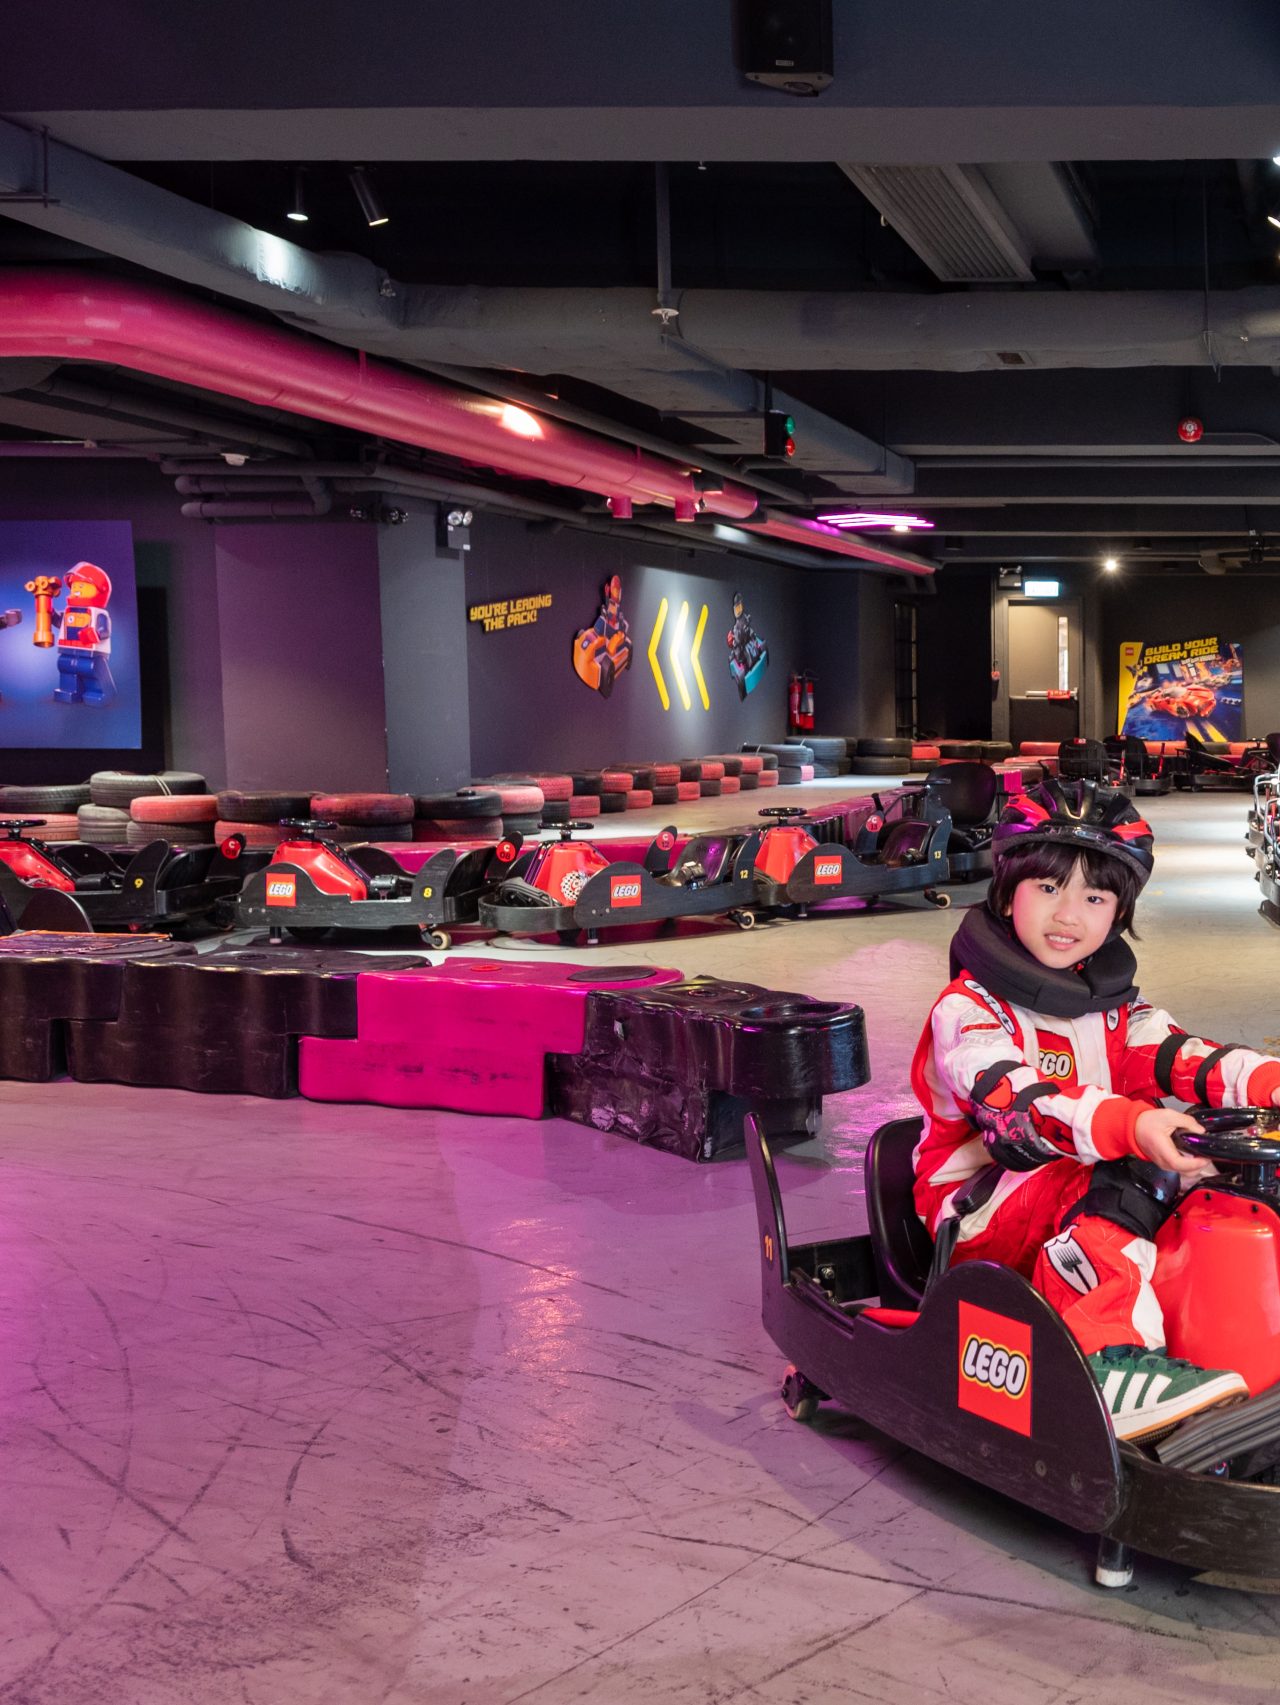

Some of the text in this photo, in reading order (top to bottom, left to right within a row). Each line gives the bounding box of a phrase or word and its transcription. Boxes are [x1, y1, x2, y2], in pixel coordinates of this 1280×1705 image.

[470, 594, 552, 621] YOU'RE LEADING
[483, 610, 537, 632] THE PACK!
[1145, 643, 1181, 656] BUILD
[1184, 637, 1218, 650] YOUR
[1143, 650, 1188, 664] DREAM
[1190, 645, 1219, 657] RIDE
[662, 833, 669, 841] C
[228, 840, 236, 849] C
[503, 844, 511, 852] C
[934, 851, 942, 859] 13
[740, 869, 748, 879] 12
[815, 864, 841, 876] LEGO
[135, 878, 143, 888] 9
[268, 883, 295, 897] LEGO
[423, 887, 432, 897] 8
[612, 884, 640, 898] LEGO
[764, 1234, 773, 1261] 11
[963, 1337, 1027, 1396] LEGO
